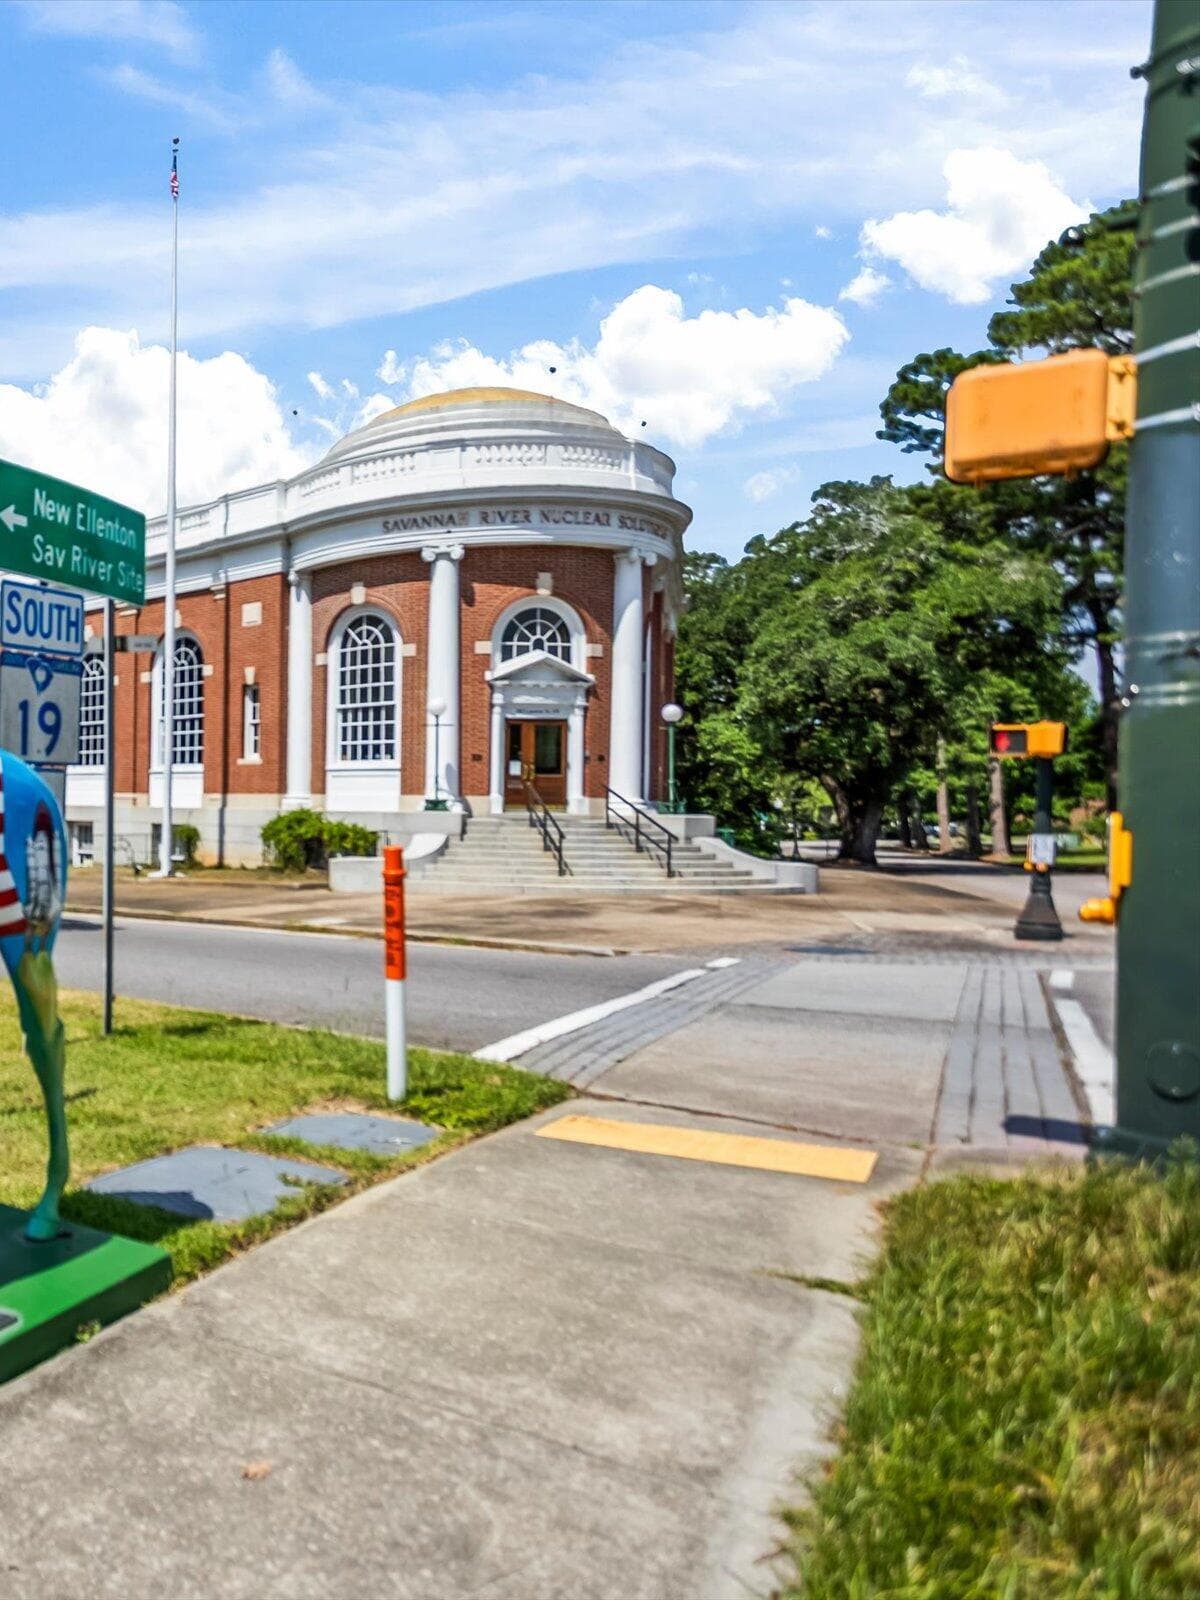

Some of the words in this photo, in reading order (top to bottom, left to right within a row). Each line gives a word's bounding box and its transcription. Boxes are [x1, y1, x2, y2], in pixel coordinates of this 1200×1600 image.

[32, 488, 71, 527] New
[76, 502, 137, 550] Ellenton
[479, 509, 531, 525] RIVER
[540, 509, 610, 528] NUCLEAR
[32, 534, 67, 569] Sav
[71, 549, 114, 583] River
[117, 560, 144, 593] Site
[5, 590, 80, 643] SOUTH
[18, 700, 62, 756] 19
